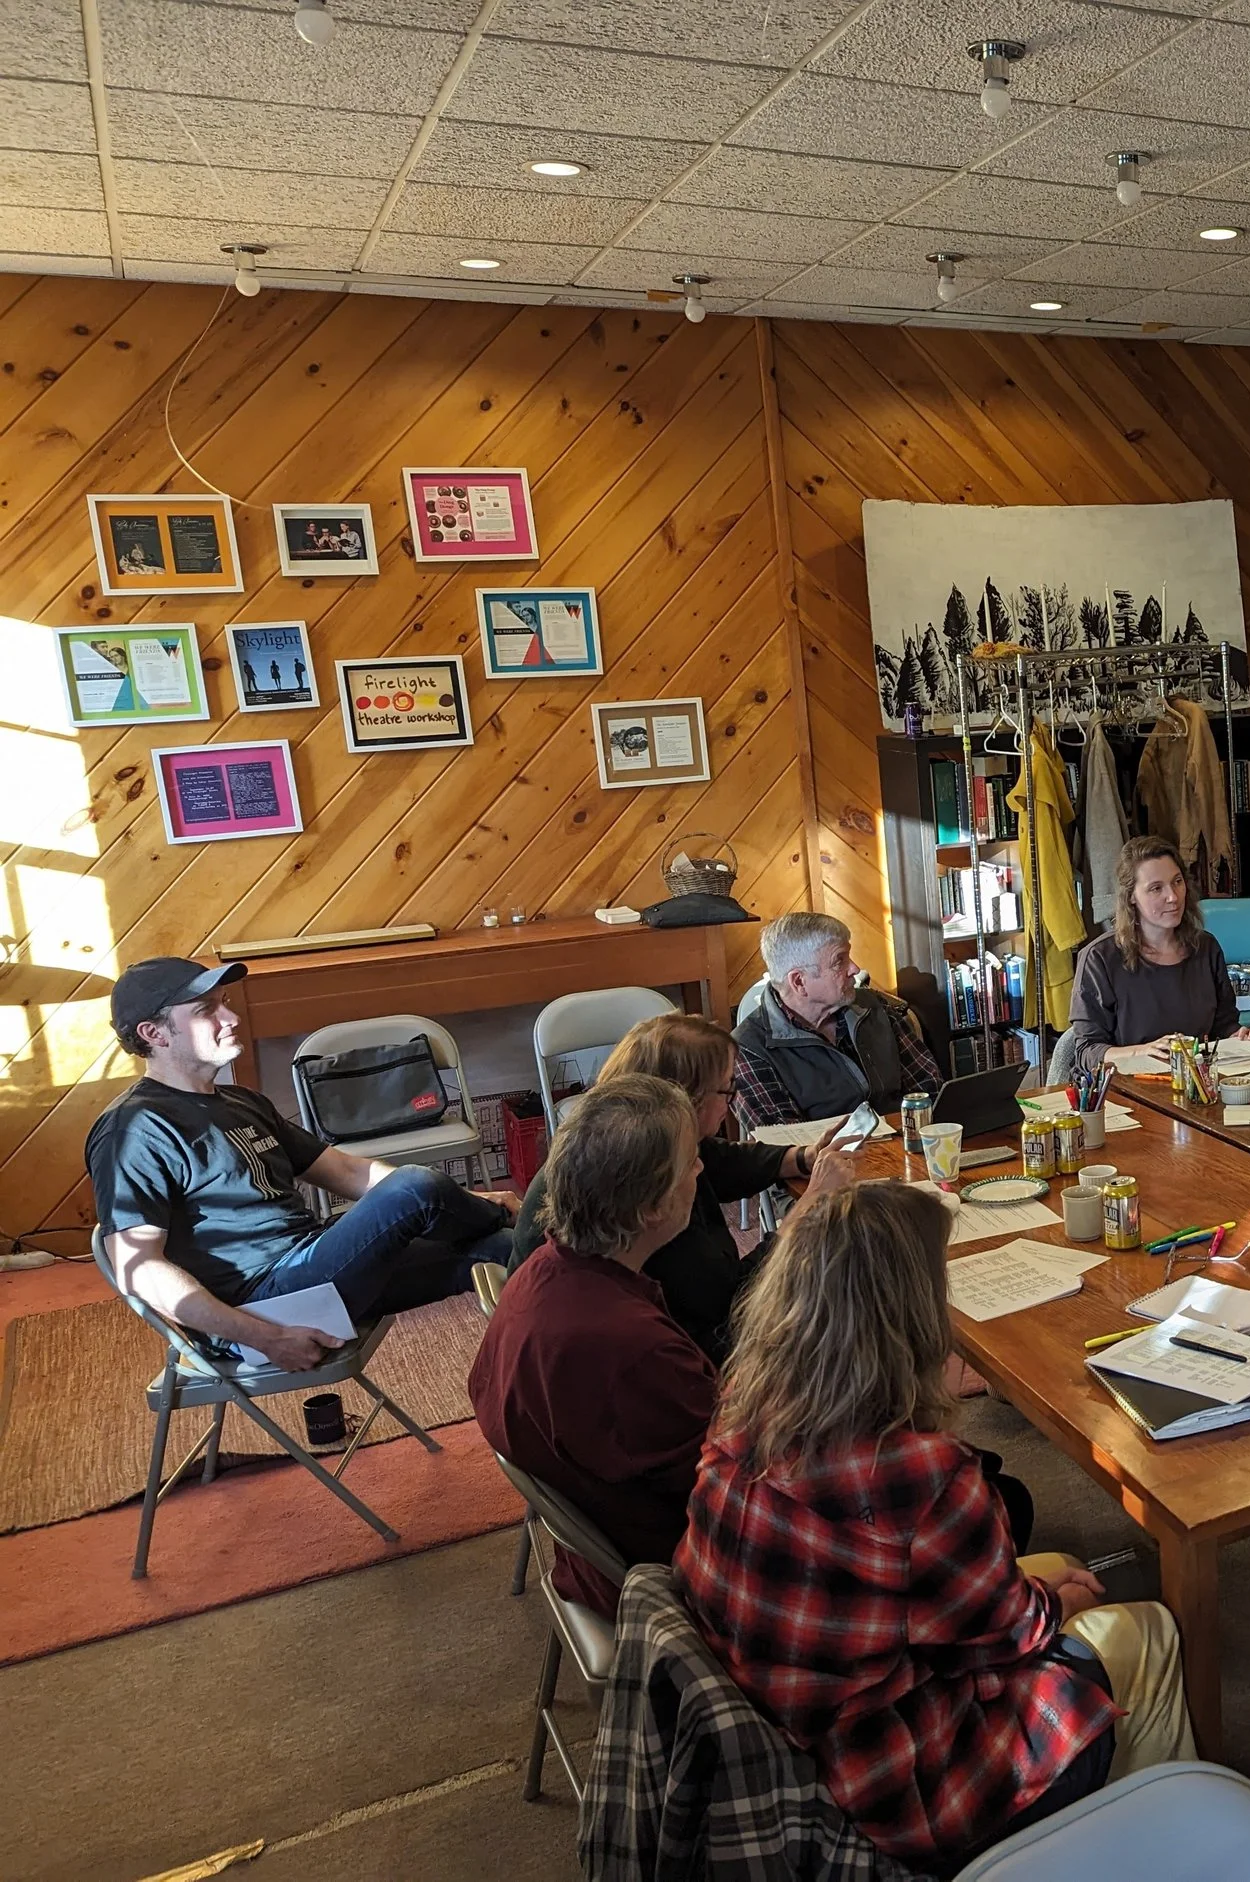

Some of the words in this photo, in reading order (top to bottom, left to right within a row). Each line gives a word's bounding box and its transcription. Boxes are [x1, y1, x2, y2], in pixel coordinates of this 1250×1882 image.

[235, 630, 300, 651] Skylight
[364, 674, 437, 694] firelight
[358, 711, 402, 726] theatre
[407, 711, 455, 725] workshop
[242, 1125, 258, 1139] THE
[1024, 1143, 1043, 1154] POLAR
